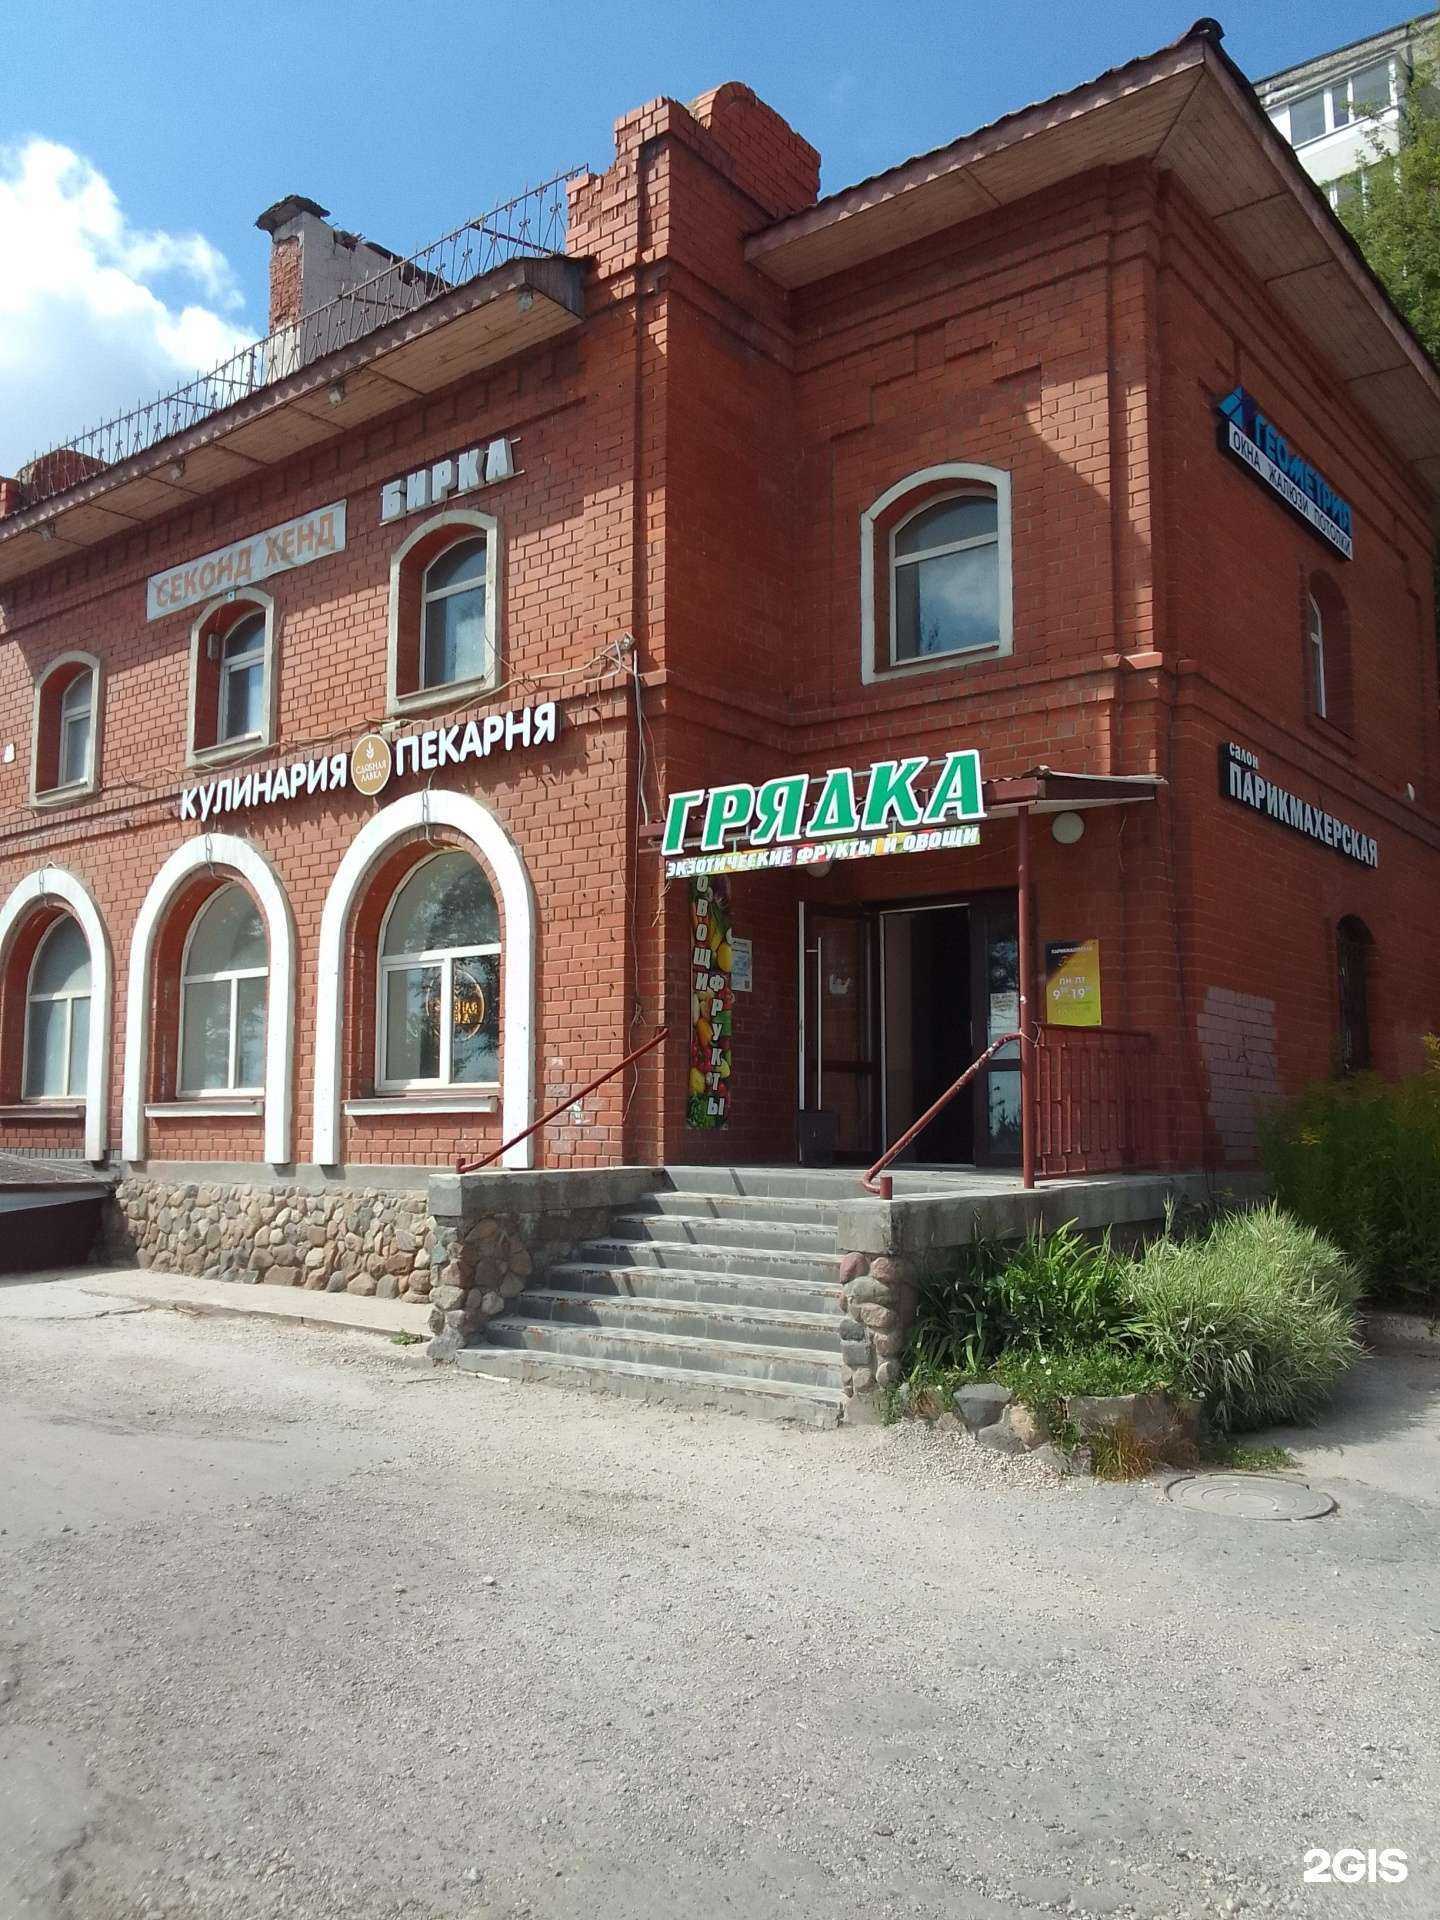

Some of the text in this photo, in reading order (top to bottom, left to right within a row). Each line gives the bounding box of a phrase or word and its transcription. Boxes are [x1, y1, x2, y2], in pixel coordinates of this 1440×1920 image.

[382, 437, 515, 522] БИРКА
[1233, 431, 1351, 554] ОКНА ЖАЛЮЗИ ПОТОЛКИ
[155, 511, 336, 608] СЕКОНД ХЕНД
[179, 752, 348, 822] КУЛИНАРИЯ
[396, 701, 557, 777] ПЕКАРНЯ
[1229, 742, 1259, 769] салон
[661, 748, 988, 856] ГРЯДКА
[1229, 761, 1378, 868] ПАРИКМАХЕРСКАЯ
[666, 826, 980, 878] ЭКЗОТИЧЕСКИЕ ФРУКТЫ И ОВОЩИ
[693, 875, 712, 991] ОВОЩИ
[707, 974, 725, 1116] ФРУКТЫ
